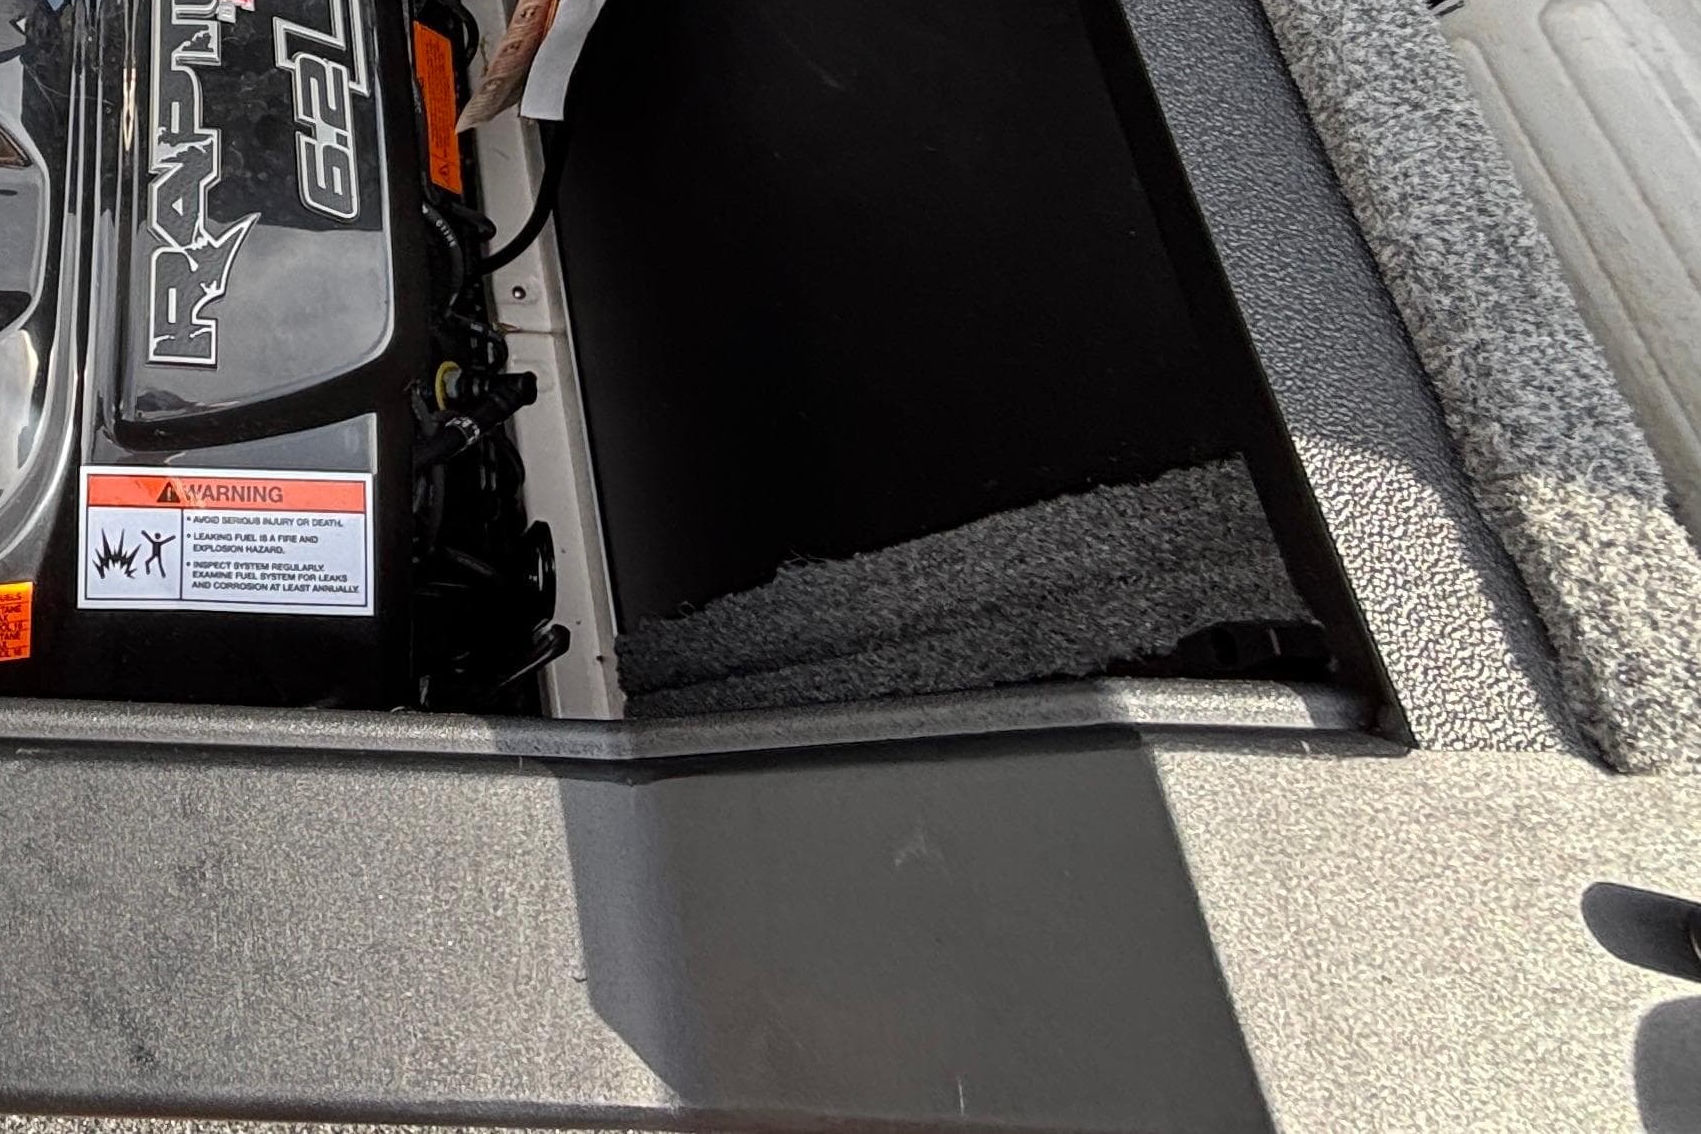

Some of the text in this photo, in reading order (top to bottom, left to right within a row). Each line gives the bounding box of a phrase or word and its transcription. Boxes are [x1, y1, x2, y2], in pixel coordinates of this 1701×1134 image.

[184, 483, 284, 503] WARNING
[193, 515, 220, 524] AVOID
[222, 516, 260, 525] SERIOUS
[263, 517, 294, 526] INJURY
[296, 518, 310, 526] OR
[193, 532, 318, 543] LEAKING FUEL IS A FIRE AND
[193, 543, 285, 554] EXPLOSION HAZARD.
[193, 561, 231, 569] INSPECT
[233, 562, 269, 571] SYSTEM
[192, 570, 347, 582] EXAMINE FUEL SYSTEM FOR LEAKS
[192, 580, 211, 589] AND
[213, 581, 268, 591] CORROSION
[270, 583, 281, 591] AT
[283, 583, 311, 592] LEAST
